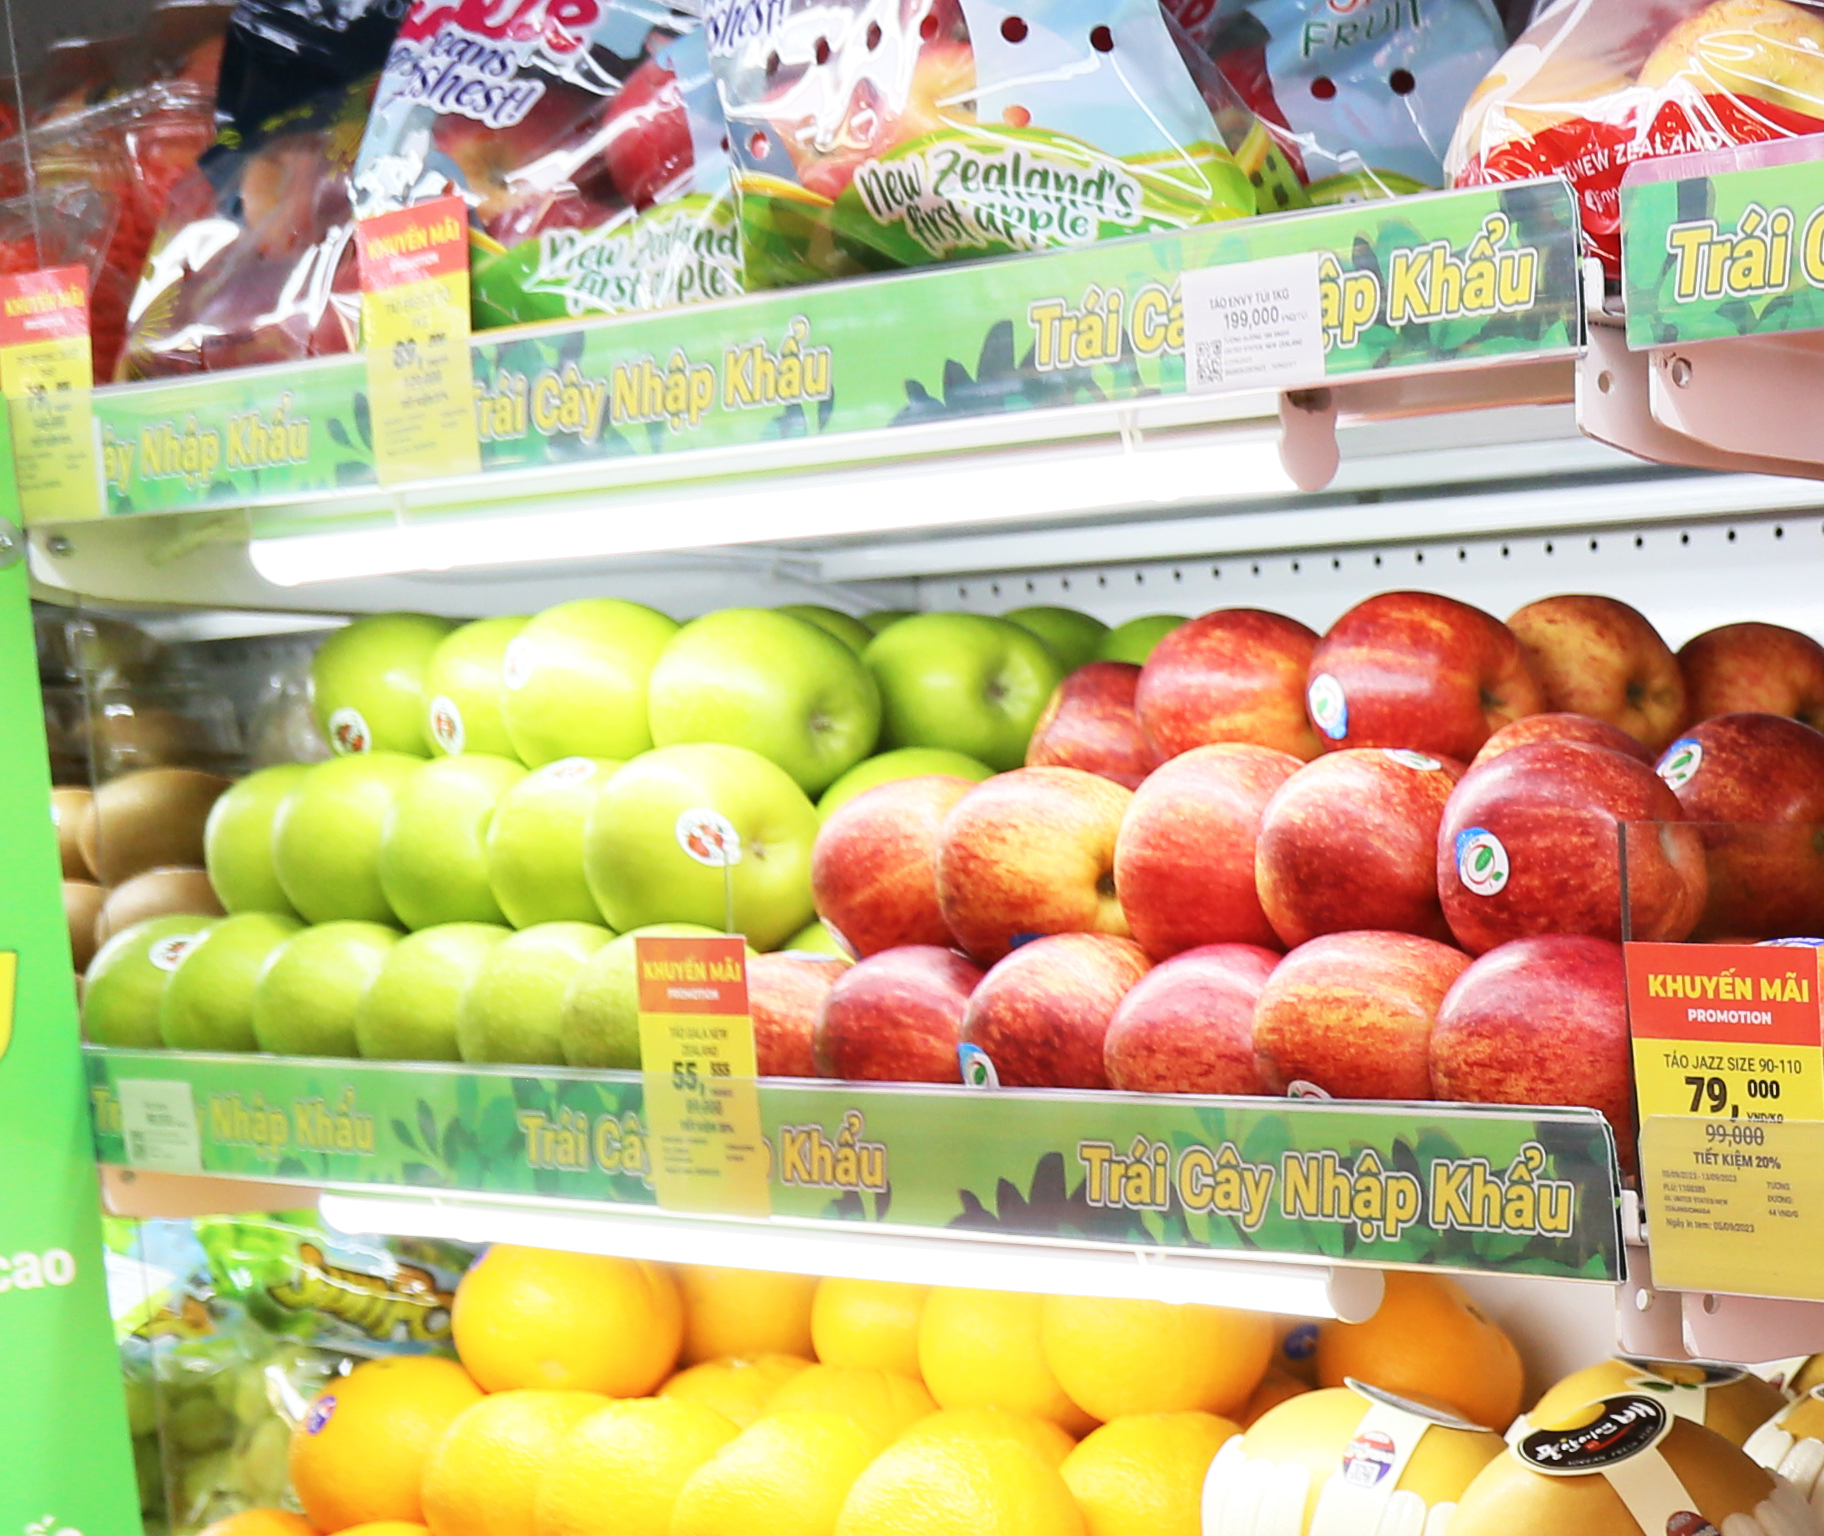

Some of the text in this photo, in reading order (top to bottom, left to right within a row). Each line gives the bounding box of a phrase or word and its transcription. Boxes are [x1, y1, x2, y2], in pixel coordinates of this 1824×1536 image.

[859, 146, 1136, 221] New Zealand's
[907, 203, 1089, 250] first apple
[1669, 204, 1791, 301] Trái
[1031, 285, 1125, 369] Trái
[1389, 213, 1537, 323] Khẩu
[1224, 305, 1280, 330] 199,000
[532, 364, 604, 438] Cây
[613, 346, 712, 431] Nhập
[724, 316, 832, 410] Khẩu
[141, 414, 221, 488] Nhập
[228, 391, 310, 472] Khẩu
[643, 955, 743, 982] KHUYẾN MÃI
[1648, 968, 1810, 1002] KHUYẾN MÃI
[1687, 1008, 1772, 1025] PROMOTION
[1663, 1050, 1802, 1074] TÁO JAZZ SIZE 90-110
[210, 1091, 288, 1161] Nhập
[294, 1083, 375, 1156] Khẩu
[1684, 1076, 1780, 1122] 79, 000
[520, 1103, 588, 1172] Trái
[781, 1109, 888, 1192] Khẩu
[1693, 1147, 1781, 1170] TIẾT KIỆM 20%
[1705, 1123, 1765, 1147] 99,000
[1079, 1135, 1575, 1244] Trái Cây Nhập Khẩu
